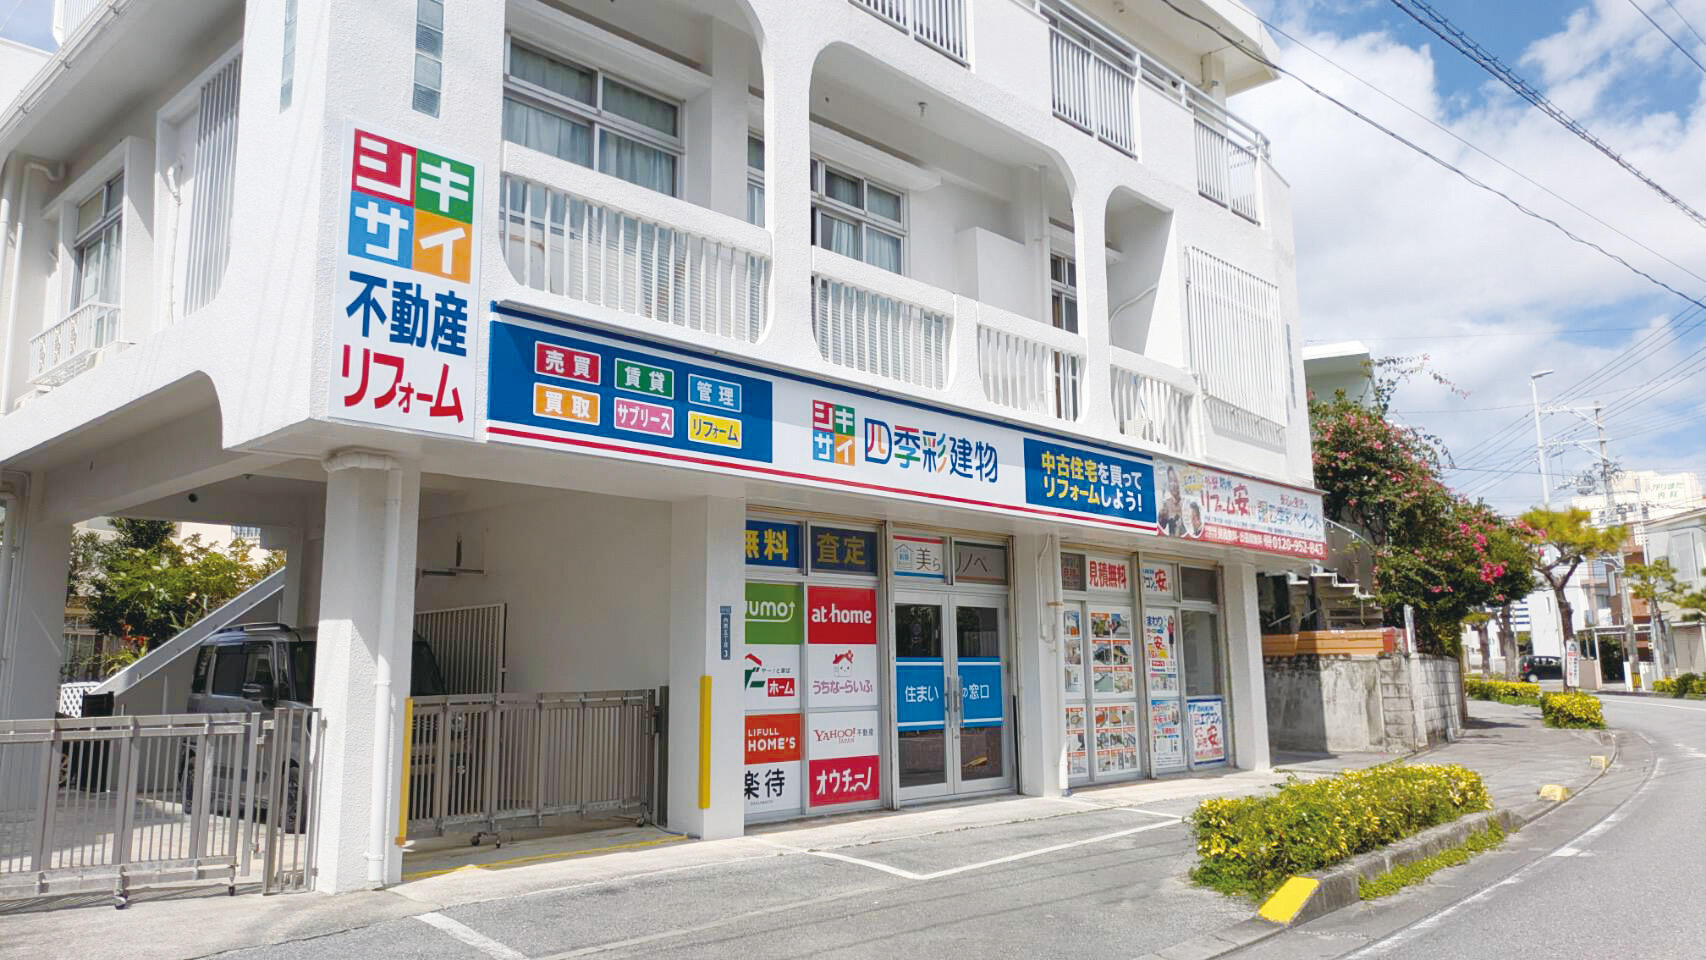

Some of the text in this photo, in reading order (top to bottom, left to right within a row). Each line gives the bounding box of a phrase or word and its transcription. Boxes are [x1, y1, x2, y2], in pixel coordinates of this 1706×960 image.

[357, 136, 470, 213] シキ
[354, 201, 466, 275] サイ
[345, 270, 468, 358] 不動産
[545, 350, 591, 379] 売買
[341, 343, 465, 424] リフォーム
[624, 366, 665, 393] 賃貸
[544, 391, 590, 418] 買取
[696, 380, 734, 407] 管理
[692, 419, 738, 442] リフォーム
[864, 417, 998, 483] 四季彩建物
[1041, 450, 1142, 490] 中古住宅を買って
[816, 532, 865, 565] 査定
[916, 547, 940, 571] 美ら
[1089, 560, 1127, 590] 見積無料
[811, 603, 872, 624] at home
[769, 680, 795, 696] ホーム
[812, 680, 873, 695] うちなーらいふ
[905, 685, 939, 702] 住まい
[748, 727, 779, 737] LIFULL
[748, 736, 796, 752] HOME'S
[814, 728, 856, 742] YAHOO!
